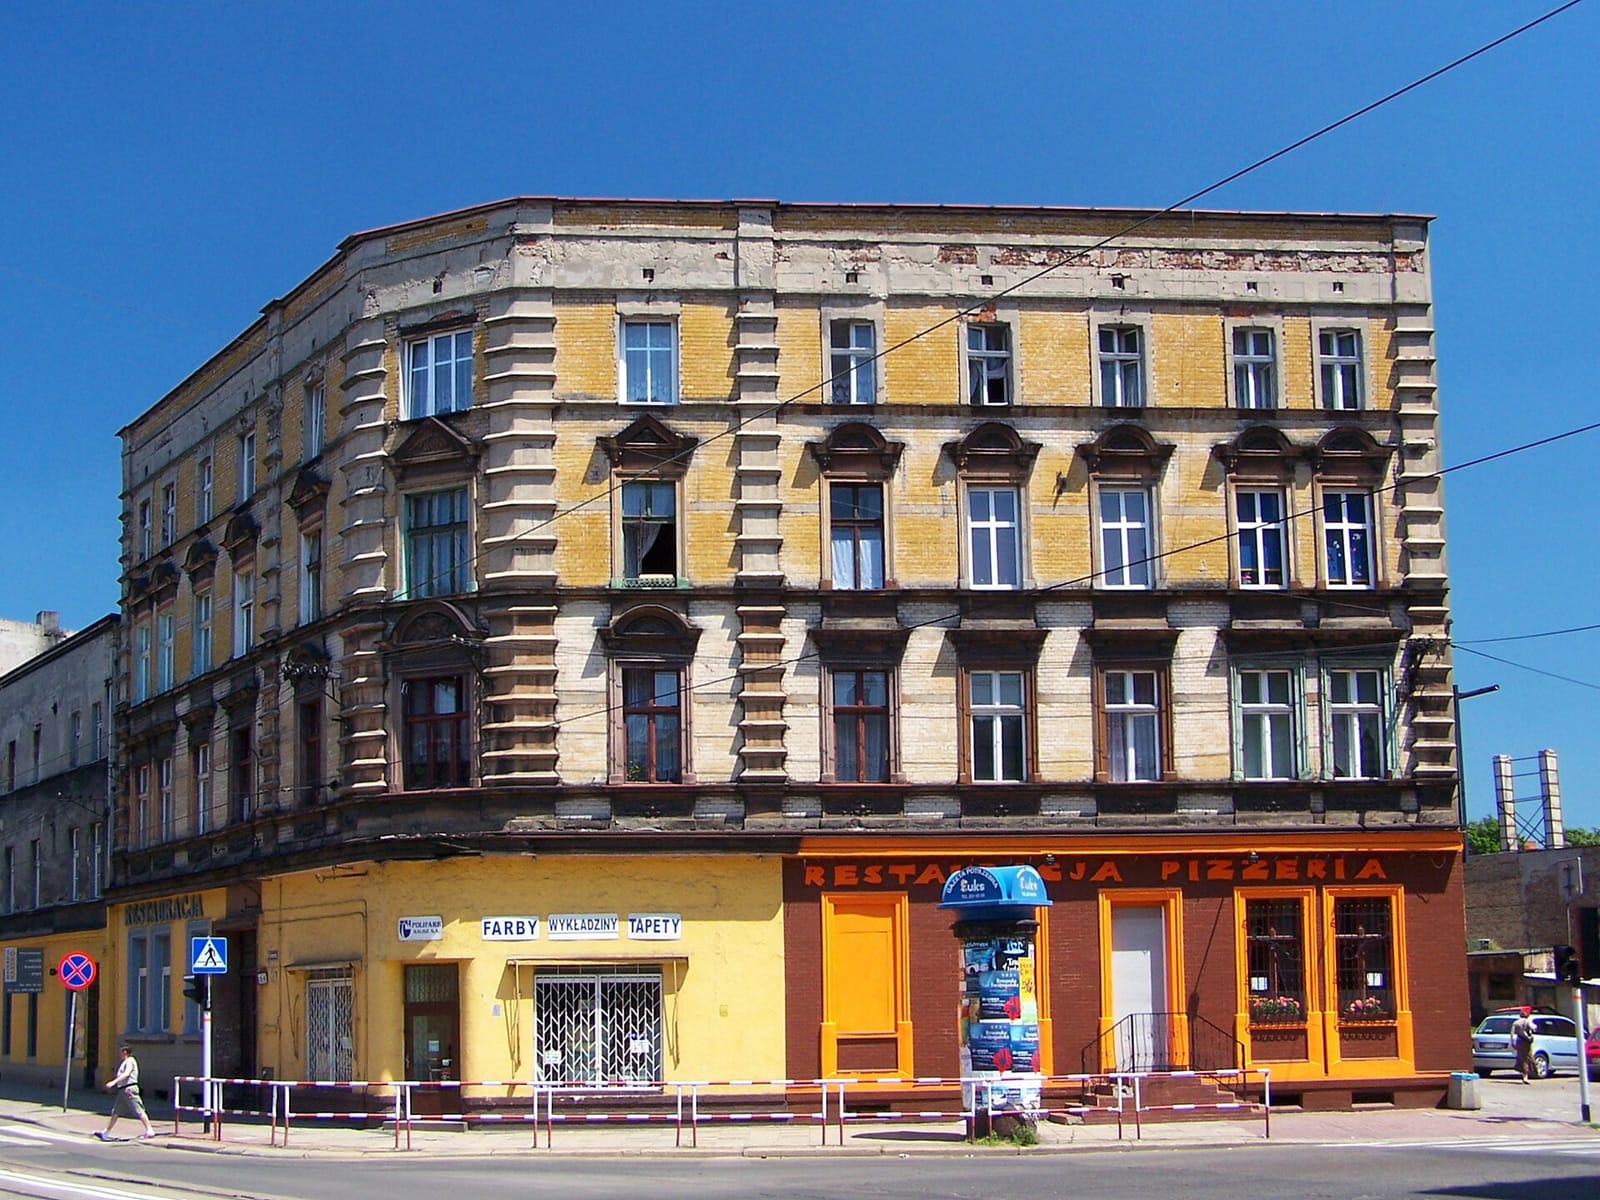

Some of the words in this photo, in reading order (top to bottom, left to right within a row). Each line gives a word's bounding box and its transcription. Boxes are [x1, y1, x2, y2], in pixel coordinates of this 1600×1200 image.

[804, 862, 1122, 886] RESTACJA
[1161, 858, 1387, 881] PIZZERIA
[483, 919, 538, 936] FARBY
[548, 917, 618, 931] WYKŁADZINY
[629, 918, 680, 934] TAPETY
